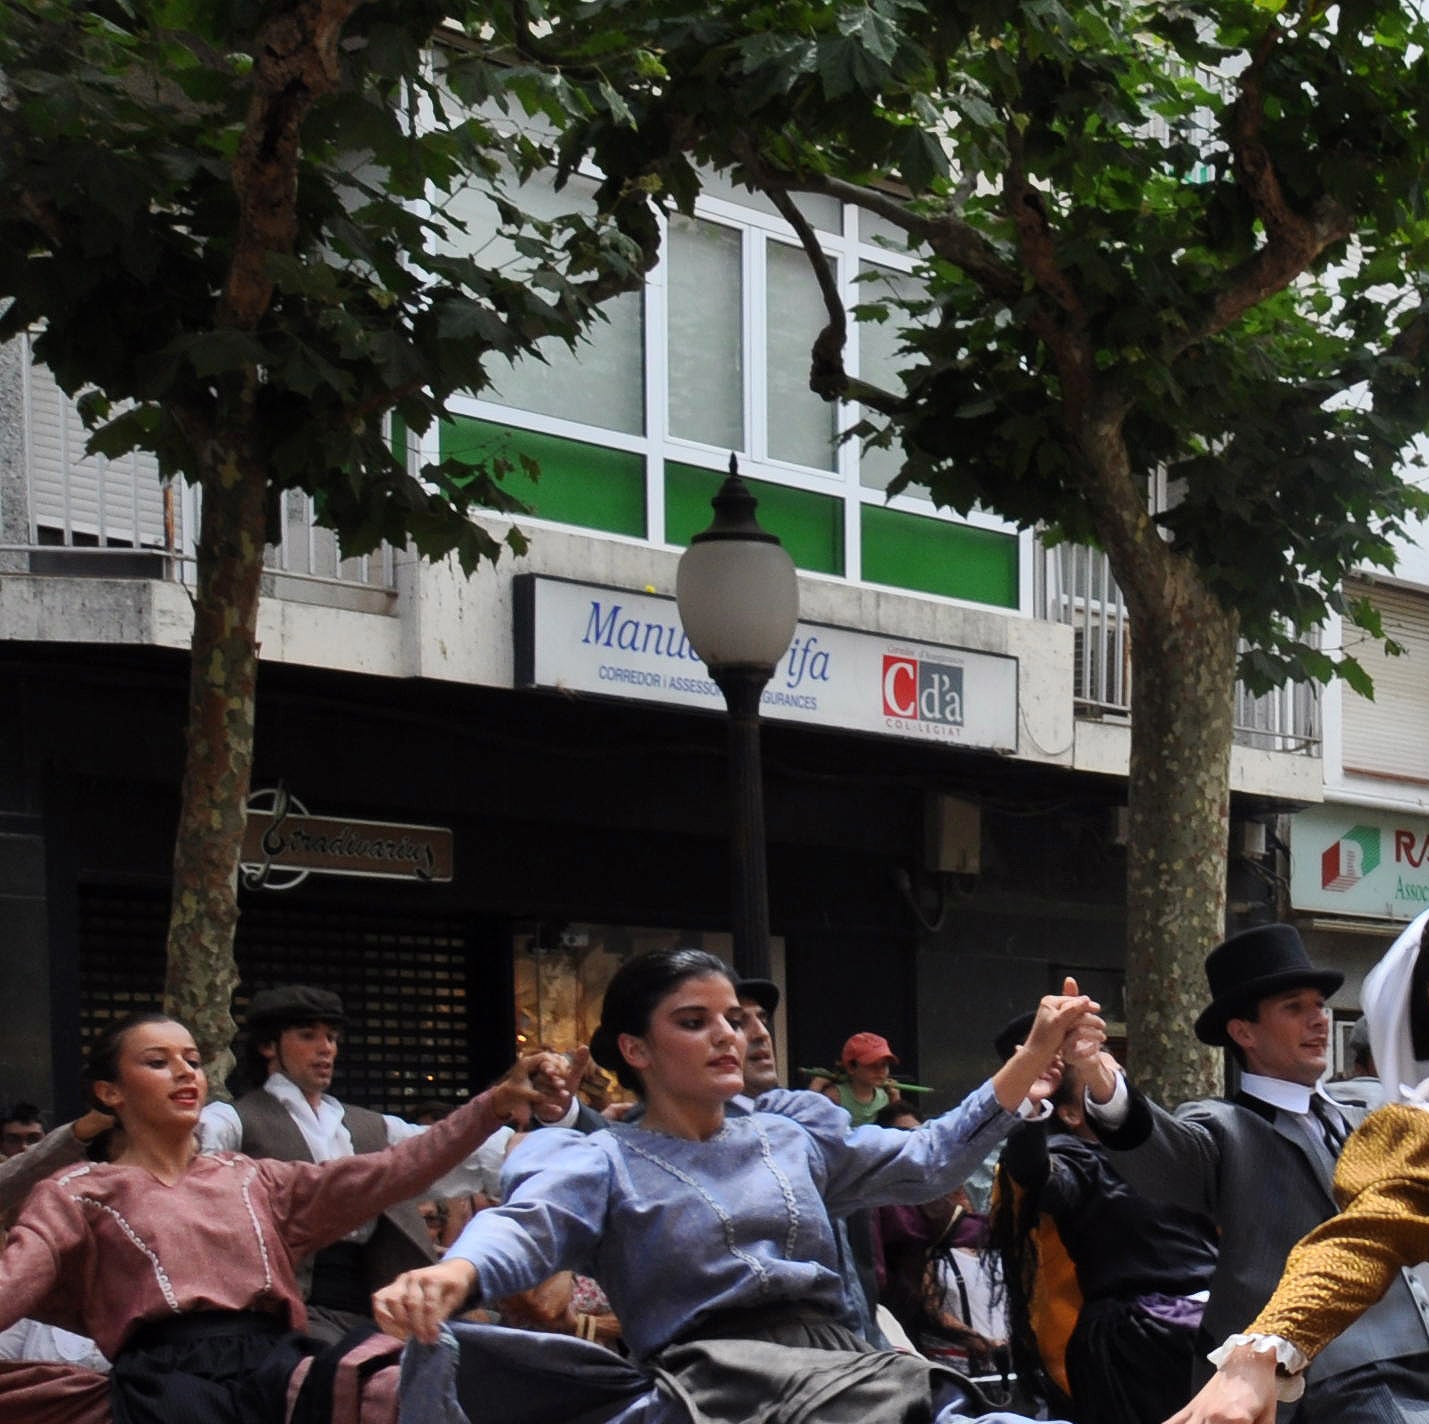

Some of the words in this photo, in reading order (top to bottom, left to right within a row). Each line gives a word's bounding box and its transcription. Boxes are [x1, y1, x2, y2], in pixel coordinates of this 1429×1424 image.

[582, 601, 702, 663] Manu
[786, 637, 831, 689] ifa
[599, 665, 662, 688] CORREDOR
[763, 690, 817, 711] GURANCES
